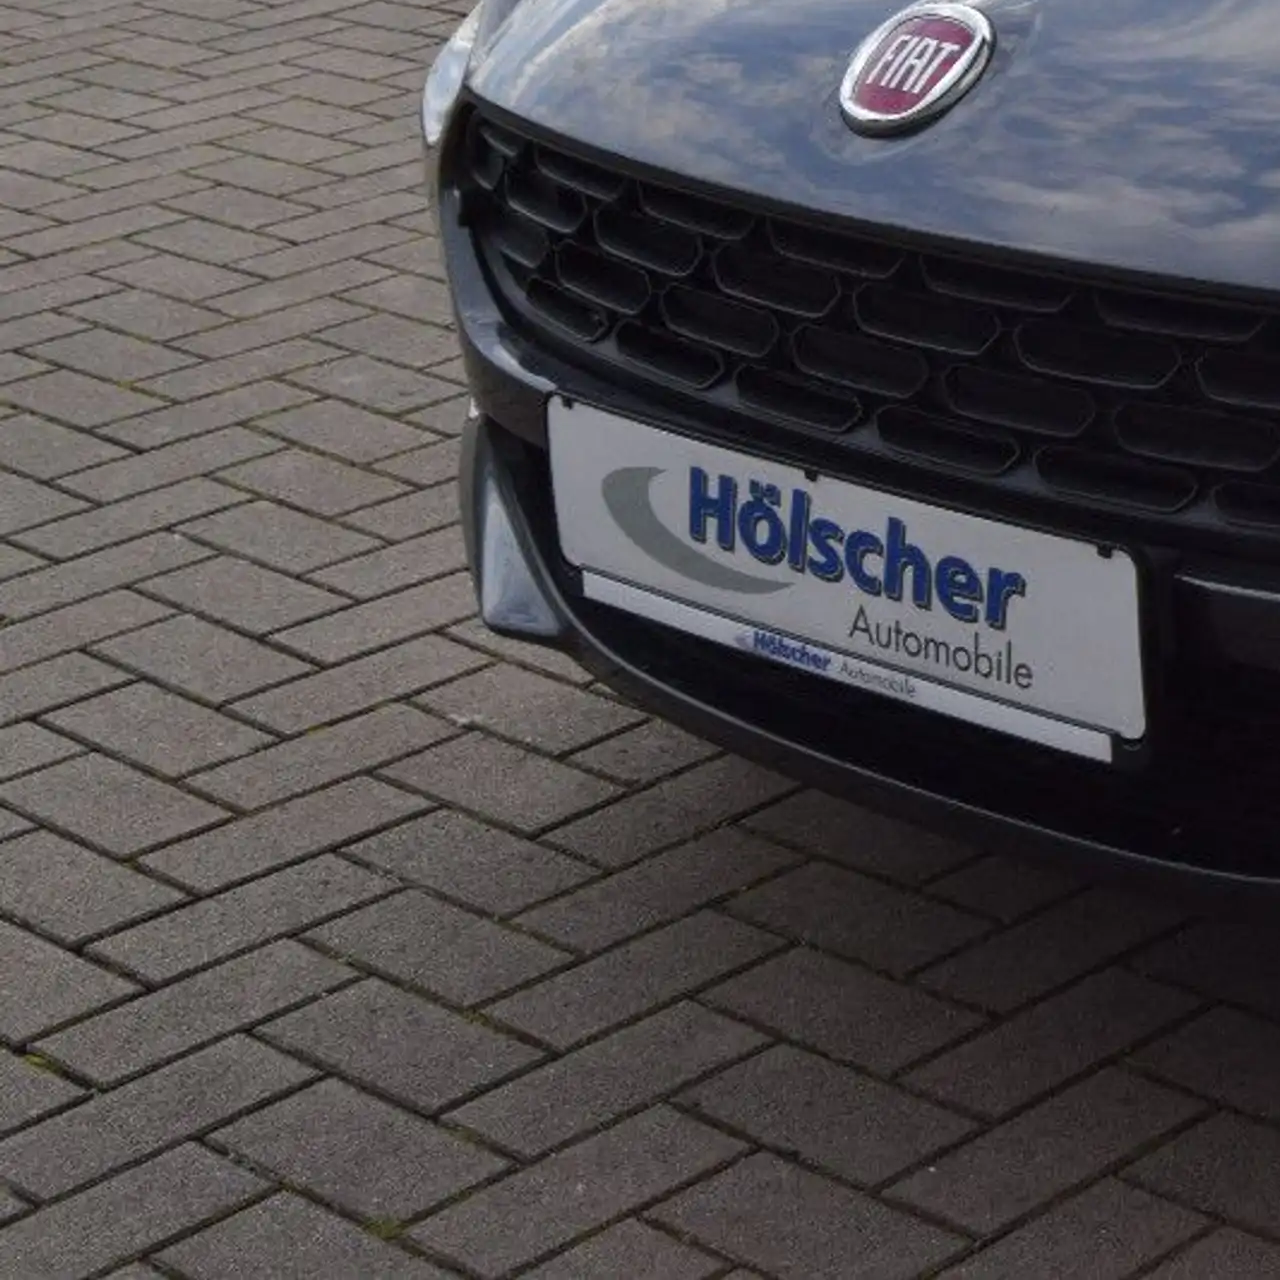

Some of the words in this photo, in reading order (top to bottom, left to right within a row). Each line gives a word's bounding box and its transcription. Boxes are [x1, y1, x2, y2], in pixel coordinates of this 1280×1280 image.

[866, 34, 961, 94] FIAT
[689, 466, 1027, 631] Hölscher
[849, 604, 1034, 690] Automobile
